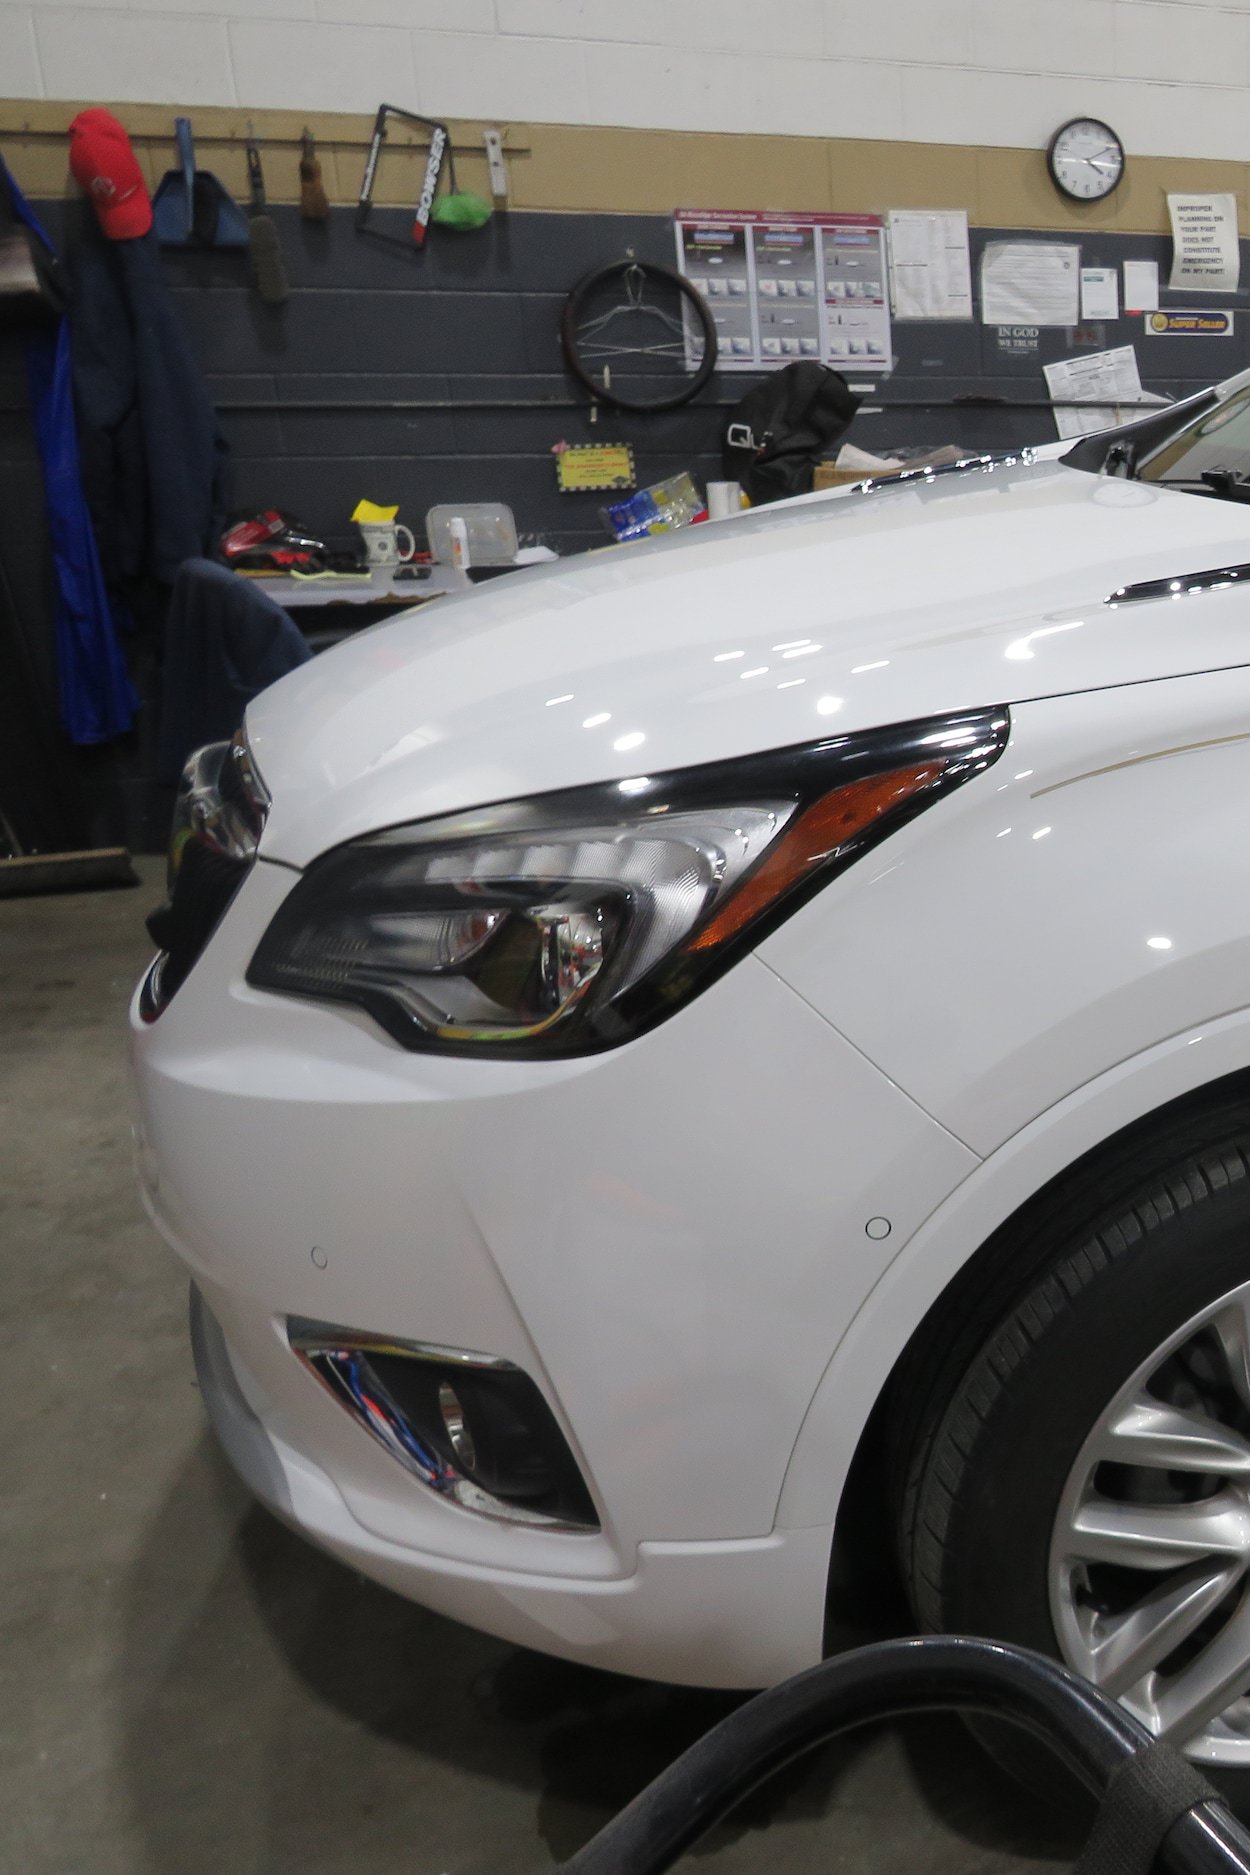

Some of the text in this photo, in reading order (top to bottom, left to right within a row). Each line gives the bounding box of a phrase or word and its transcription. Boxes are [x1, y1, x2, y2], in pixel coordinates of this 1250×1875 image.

[416, 127, 446, 226] BOWSER
[1177, 205, 1213, 213] IMPROPER
[1178, 215, 1212, 223] PLANNING
[1183, 257, 1224, 265] EMERGENCY
[998, 326, 1039, 338] IN GOD
[999, 339, 1038, 347] WE TRUST
